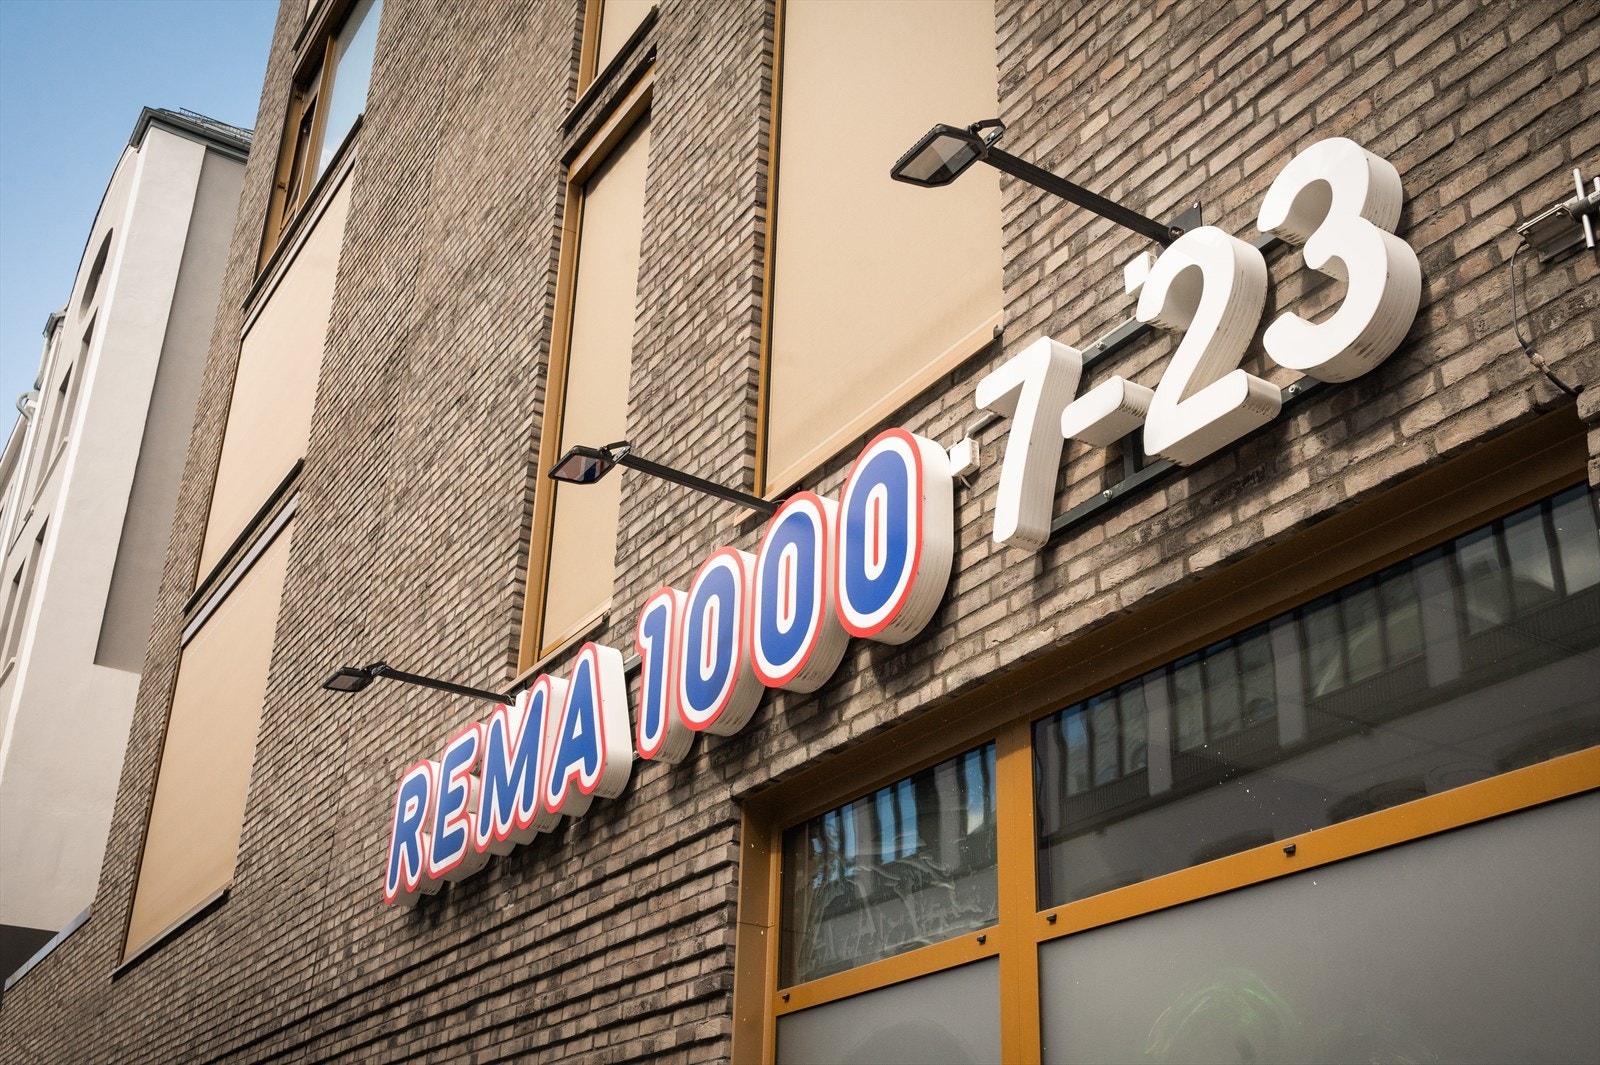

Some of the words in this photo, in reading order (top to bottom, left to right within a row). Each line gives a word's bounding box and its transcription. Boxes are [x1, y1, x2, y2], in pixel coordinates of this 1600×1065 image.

[384, 642, 607, 904] REMA
[636, 428, 924, 760] 1000
[975, 137, 1394, 545] 7-23
